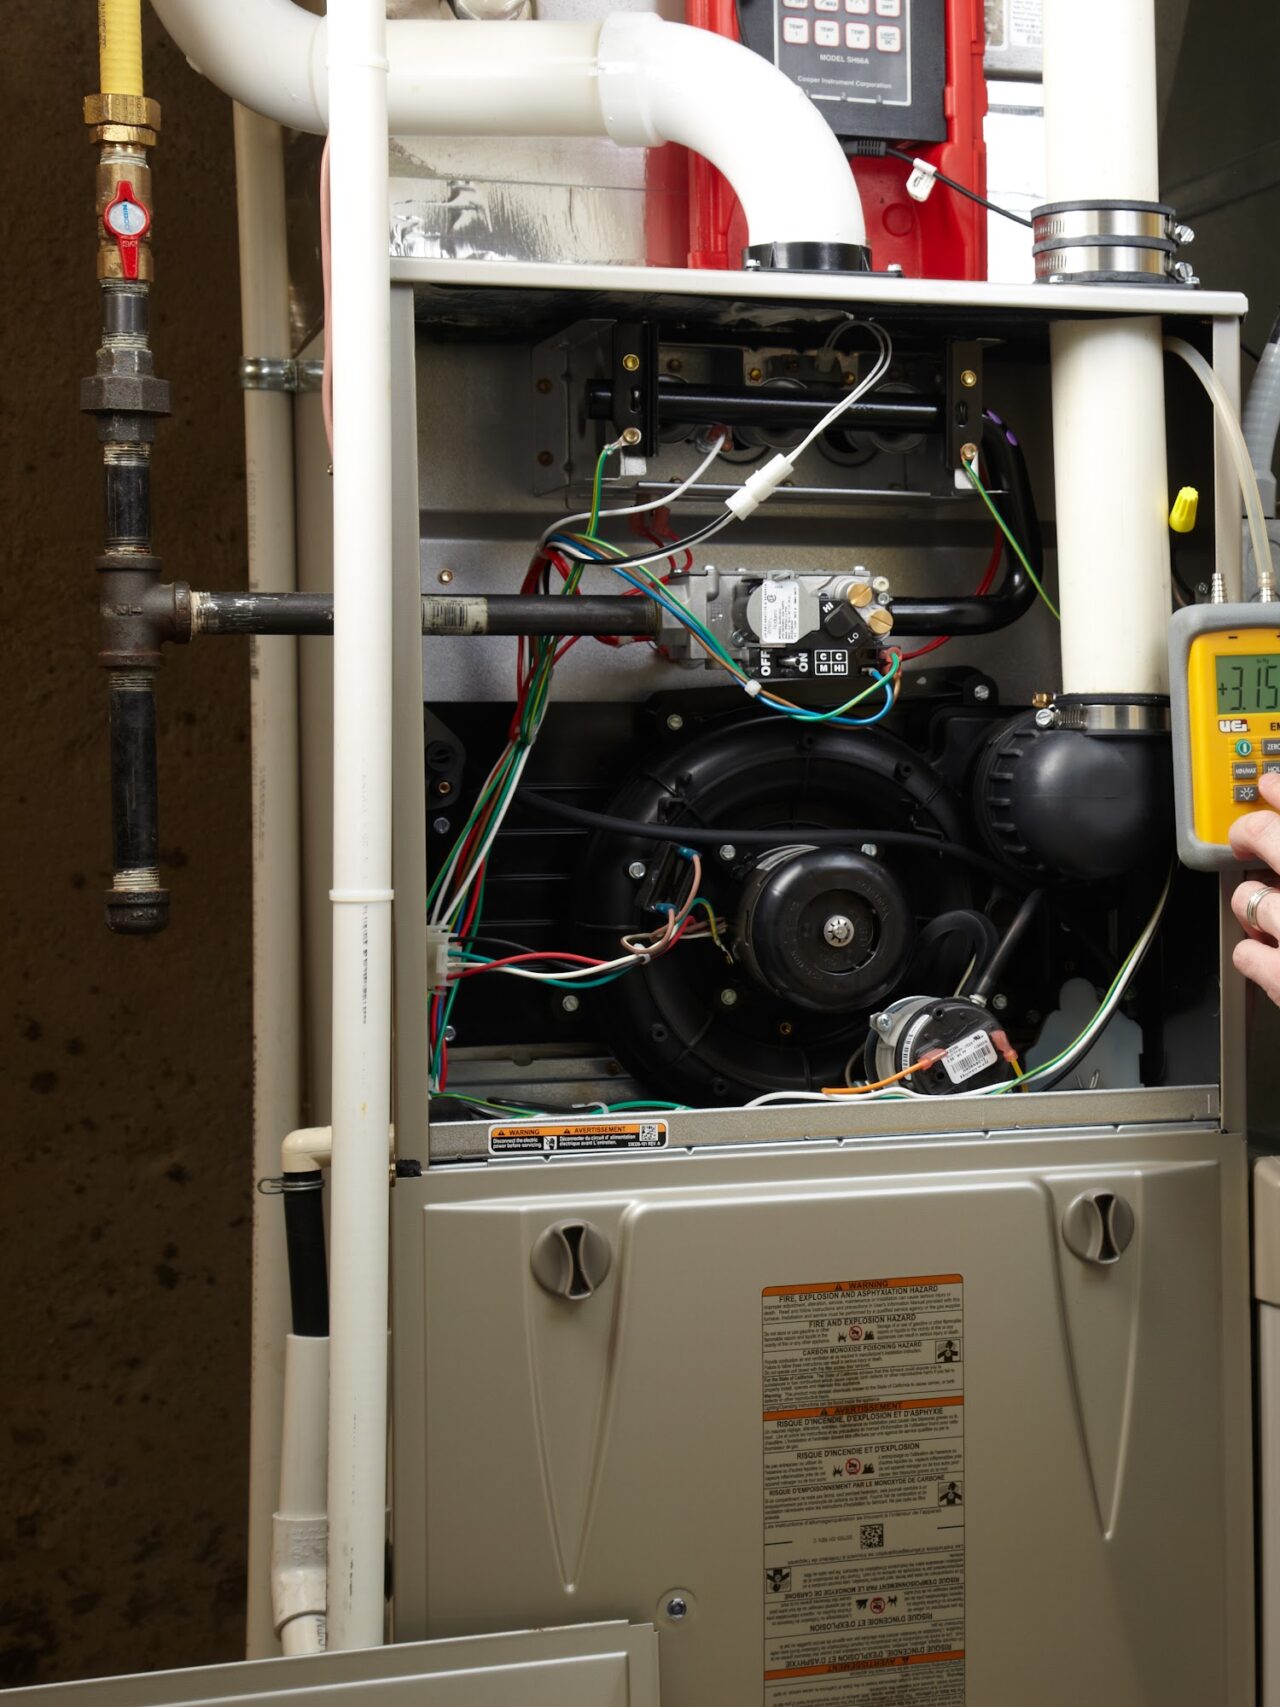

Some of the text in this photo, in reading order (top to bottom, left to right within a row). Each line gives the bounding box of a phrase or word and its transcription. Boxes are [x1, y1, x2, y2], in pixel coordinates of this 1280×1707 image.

[820, 54, 845, 63] MODEL
[798, 75, 893, 89] Cooper Instrument Corporation
[822, 601, 834, 614] HI
[847, 632, 859, 643] LO
[761, 651, 771, 676] OFF
[799, 652, 808, 672] ON
[820, 663, 845, 673] M HI
[1235, 767, 1257, 775] MIN/MAX
[574, 1126, 626, 1134] AVERTISSEMENT
[848, 1280, 889, 1289] WARNING
[779, 1285, 939, 1303] FIRE, EXPLOSION AND ASPHYXIATION HAZARD
[809, 1313, 916, 1328] FIRE AND EXPLOSION HAZARD
[802, 1340, 922, 1356] CARBON MONOXIDE POISONING HAZARD
[834, 1401, 903, 1414] AVERTISSEMENT
[777, 1418, 803, 1428] RISQUE
[846, 1411, 893, 1422] D'EXPLOSION
[894, 1410, 903, 1418] ET
[904, 1407, 944, 1417] D'ASPHYXIE
[796, 1450, 824, 1459] RISQUE
[824, 1446, 863, 1457] D'INCENDIE
[874, 1442, 920, 1453] D'EXPLOSION
[769, 1474, 945, 1496] RISQUE D'EMPOISONNEMENT PAR LE MONOXYDE DE CARBONE
[815, 1588, 825, 1596] DE
[856, 1584, 865, 1592] LE
[785, 1590, 813, 1600] CARBONE
[809, 1612, 933, 1632] RISQUE D'INCENDIE ET D'EXPLOSION
[927, 1643, 953, 1652] RISQUE
[785, 1656, 827, 1667] D'ASPHYXIE
[838, 1650, 885, 1662] D'EXPLOSION
